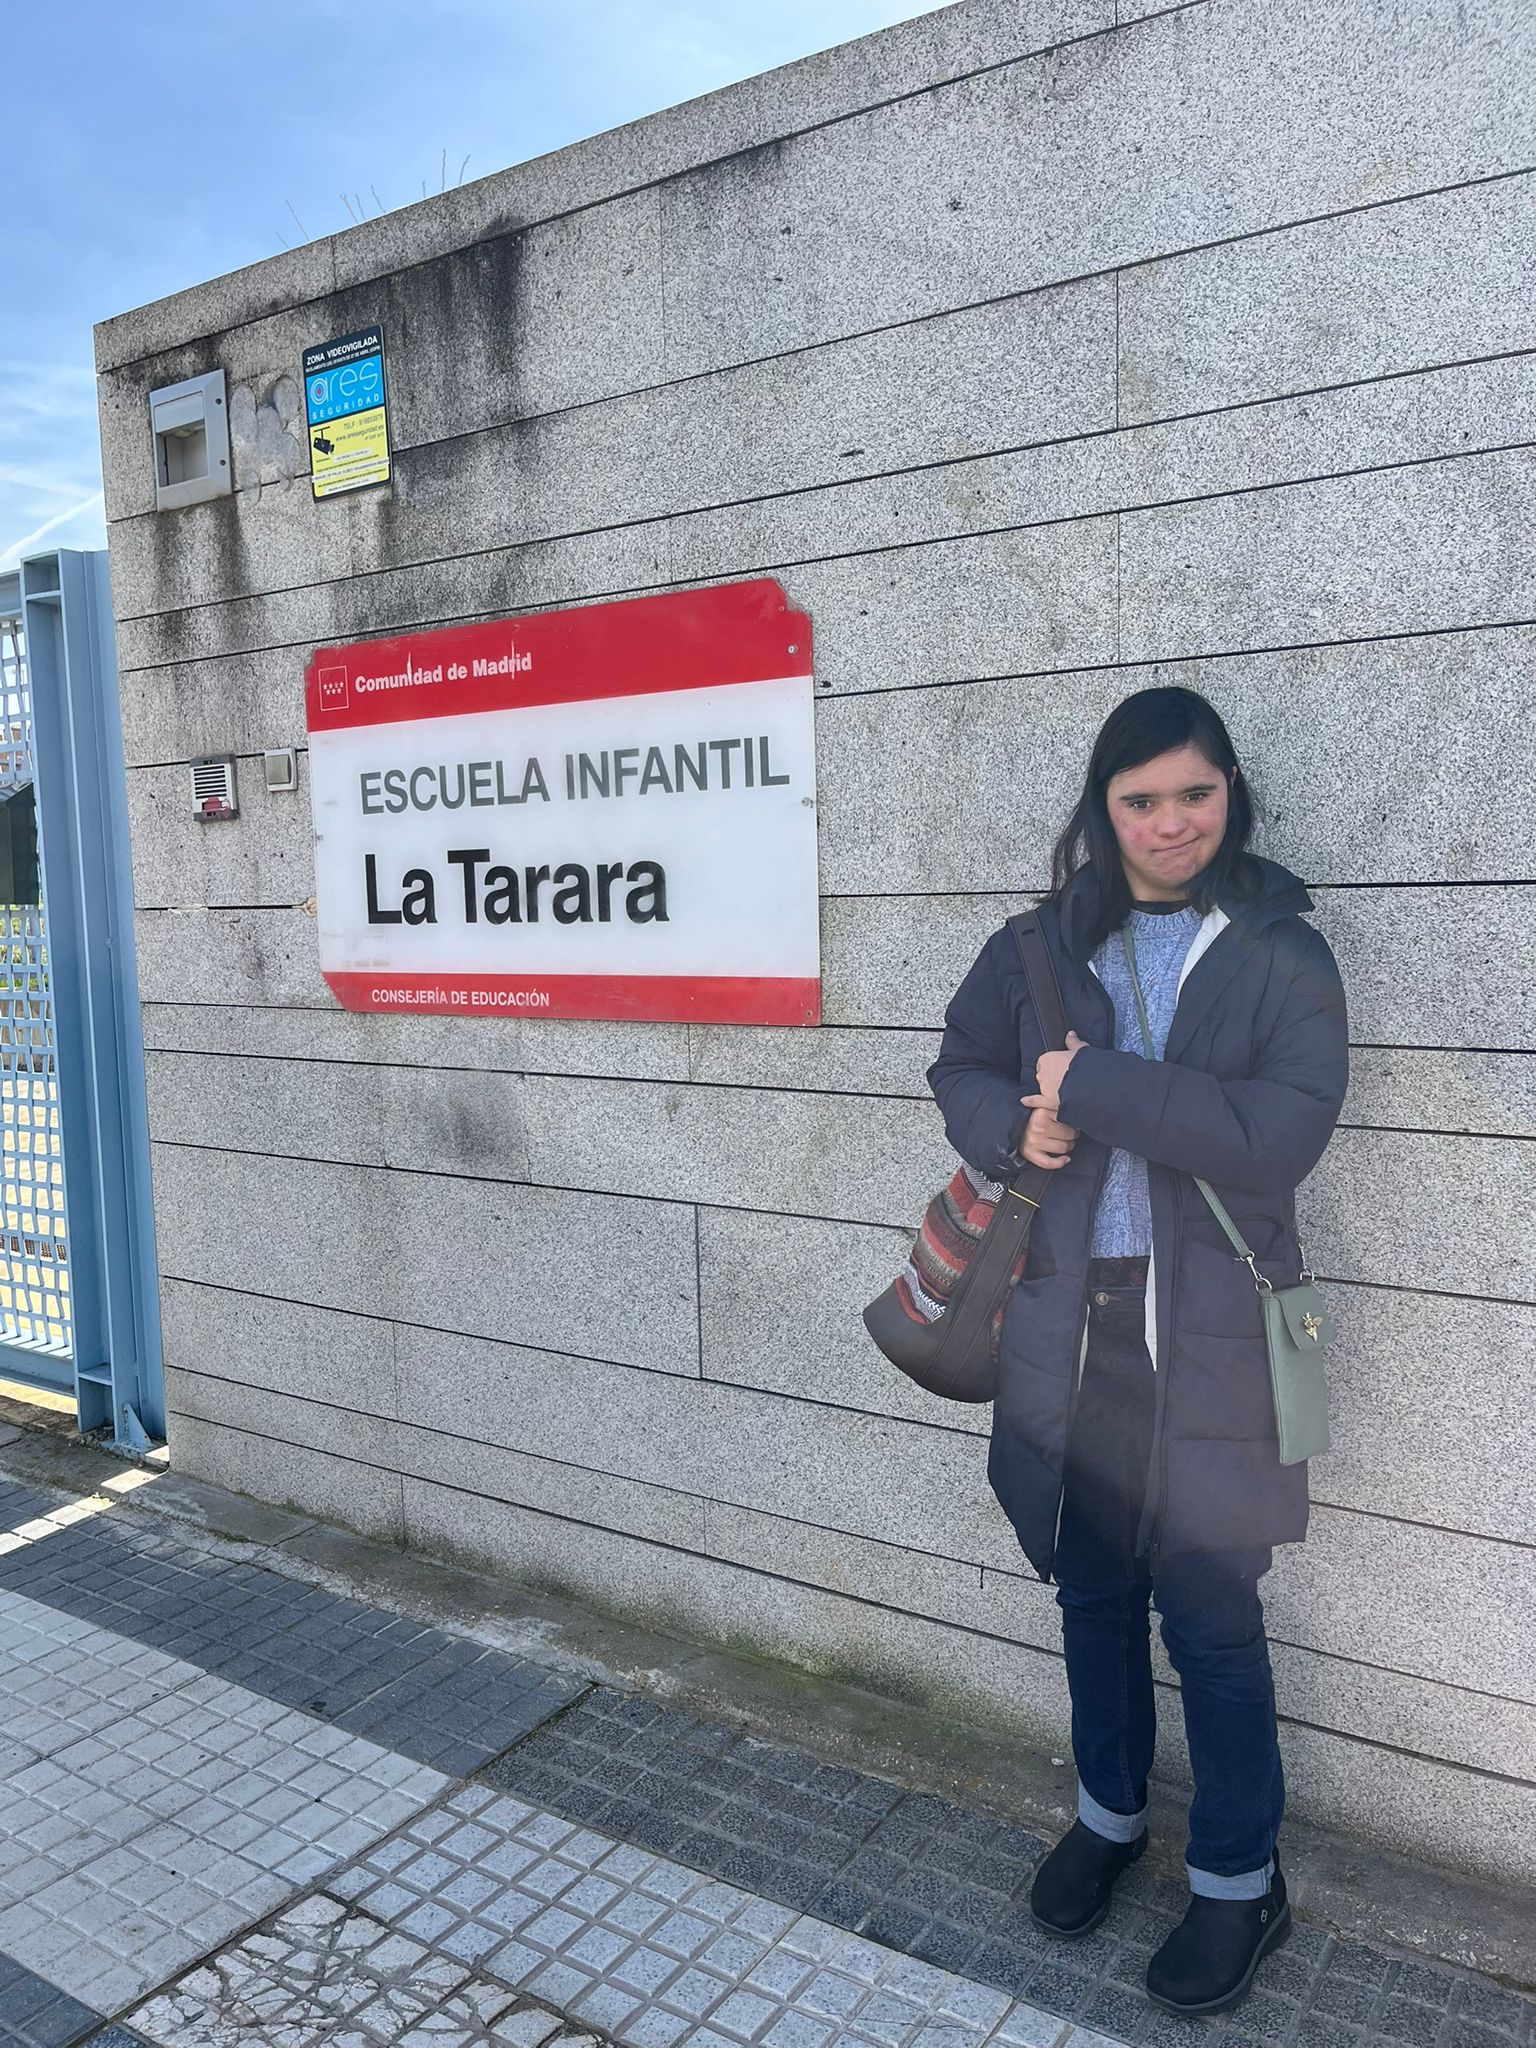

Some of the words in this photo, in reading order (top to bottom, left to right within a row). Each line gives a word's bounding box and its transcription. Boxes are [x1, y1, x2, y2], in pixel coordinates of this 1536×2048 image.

[306, 353, 325, 366] ZONA
[327, 335, 378, 359] VIDEOVIGILADA
[310, 362, 378, 405] ares
[312, 393, 380, 420] SEGURIDAD
[354, 651, 443, 693] Comunidad
[446, 663, 468, 681] de
[472, 640, 533, 679] Madrid
[360, 757, 551, 815] ESCUELA
[565, 735, 790, 800] INFANTIL
[364, 853, 438, 926] La
[447, 848, 670, 925] Tarara
[371, 986, 449, 1004] CONSEJERÍA
[451, 990, 469, 1005] DE
[471, 988, 550, 1007] EDUCACIÓN
